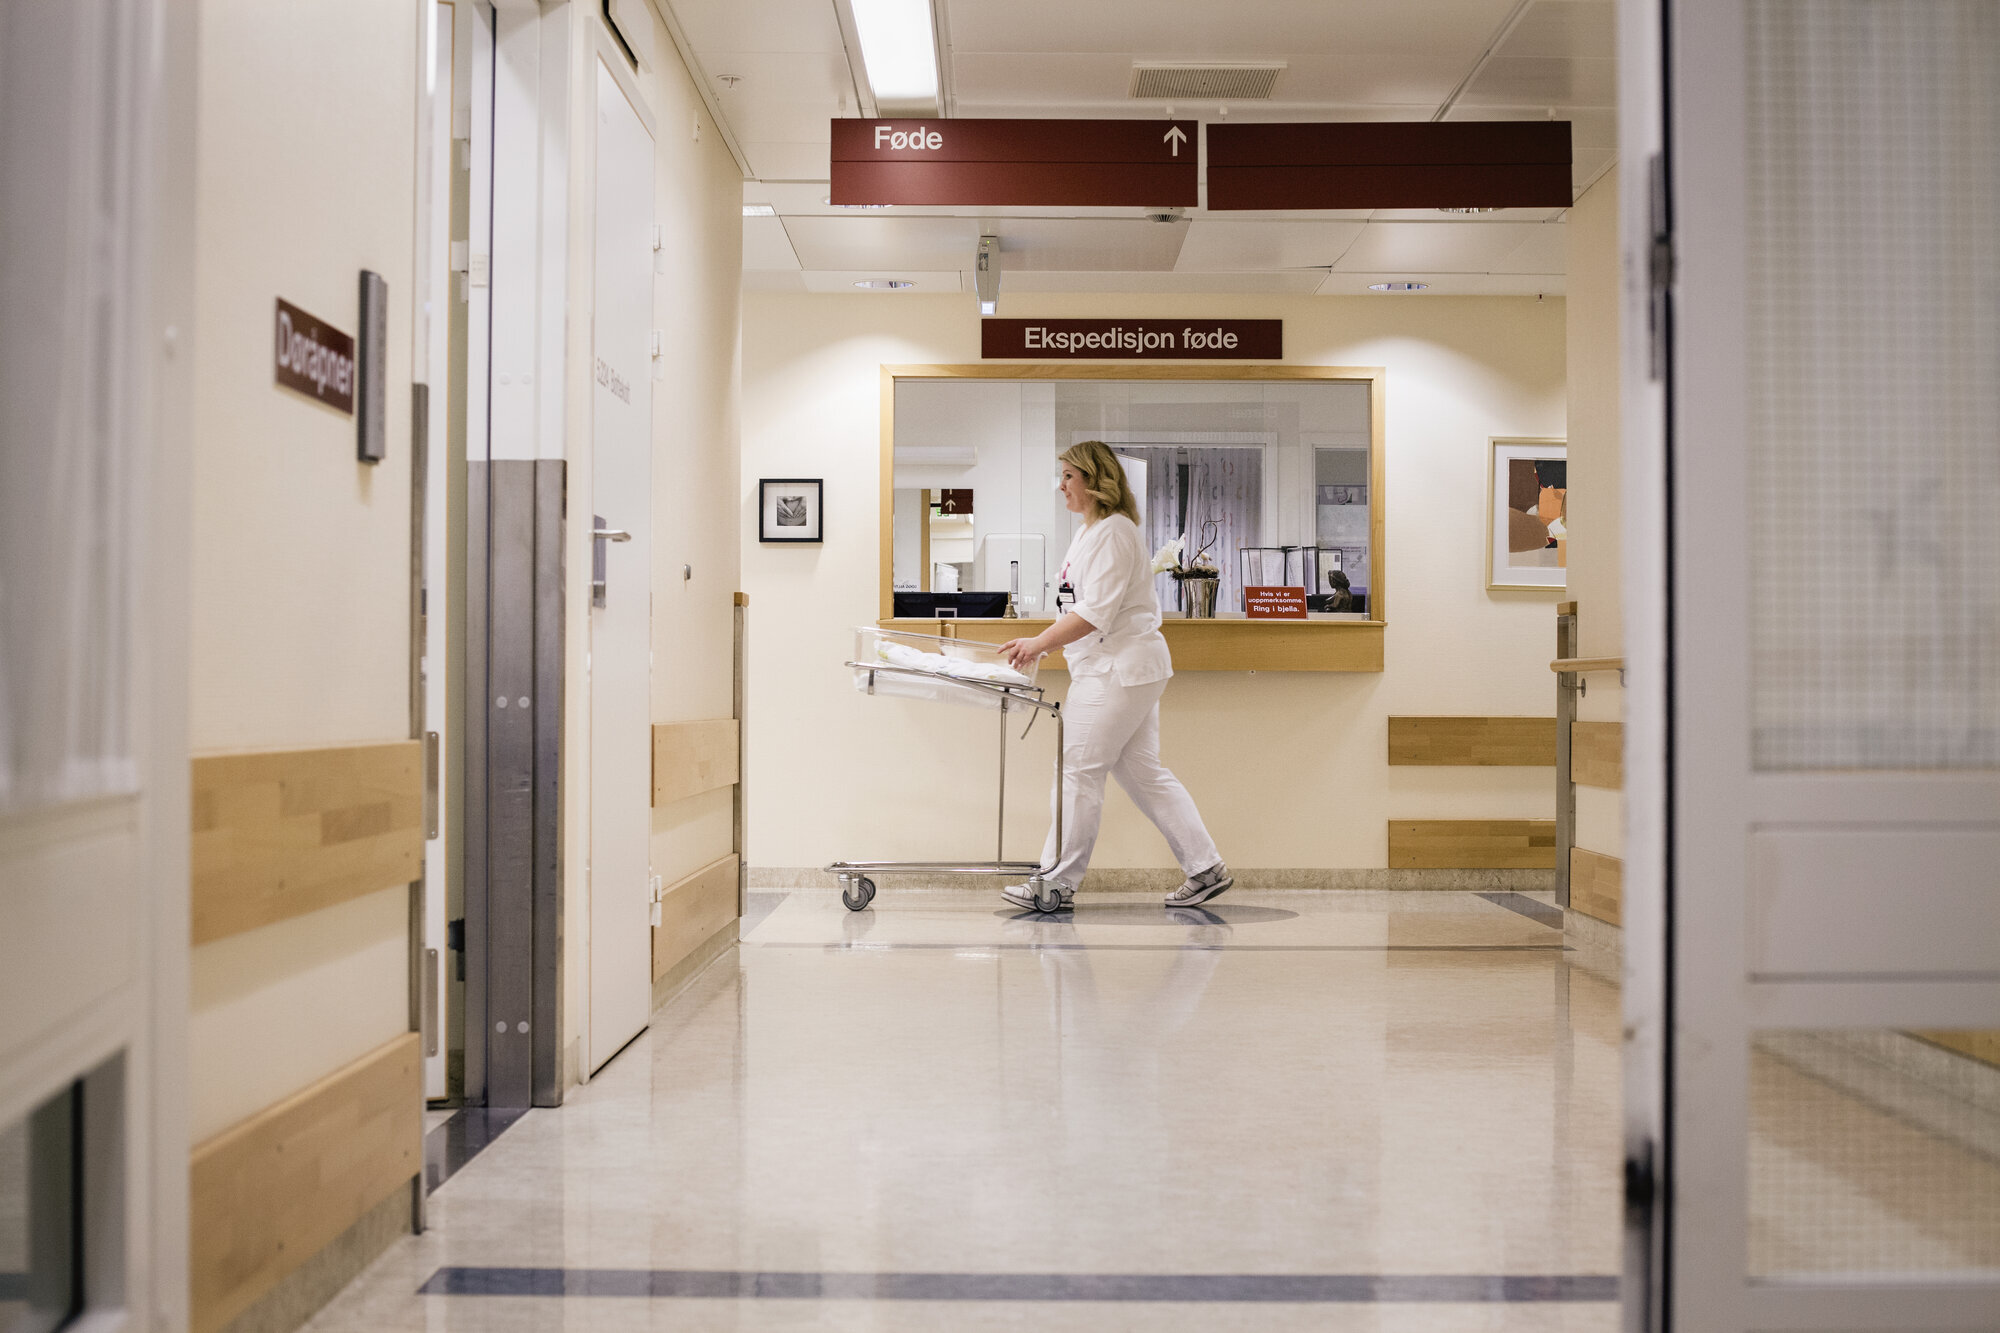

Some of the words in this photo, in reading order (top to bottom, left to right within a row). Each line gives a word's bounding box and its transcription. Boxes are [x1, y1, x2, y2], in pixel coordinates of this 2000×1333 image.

[874, 125, 943, 151] Føde
[1025, 327, 1175, 353] Ekspedisjon
[1182, 327, 1238, 350] føde
[1253, 605, 1270, 613] Ring
[1277, 605, 1300, 613] bjella.
